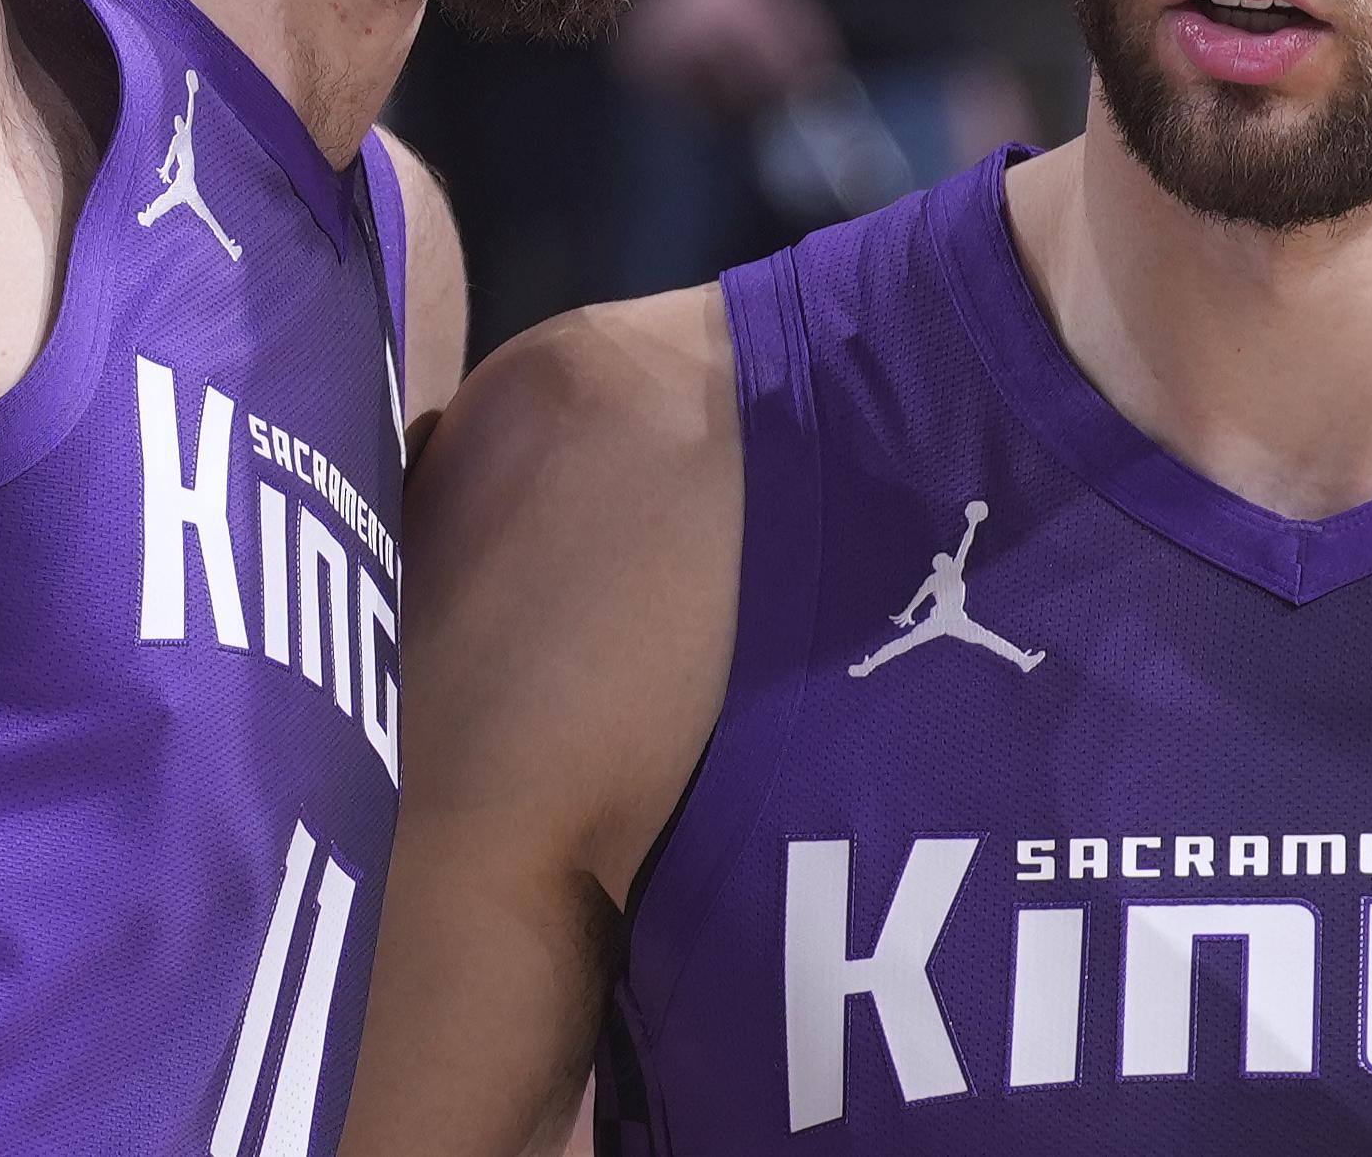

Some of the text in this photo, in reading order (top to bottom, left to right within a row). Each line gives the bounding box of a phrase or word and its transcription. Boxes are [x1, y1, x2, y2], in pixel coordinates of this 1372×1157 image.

[136, 354, 403, 790] KING
[248, 413, 394, 580] SACRAMENTO
[209, 817, 356, 1157] 11
